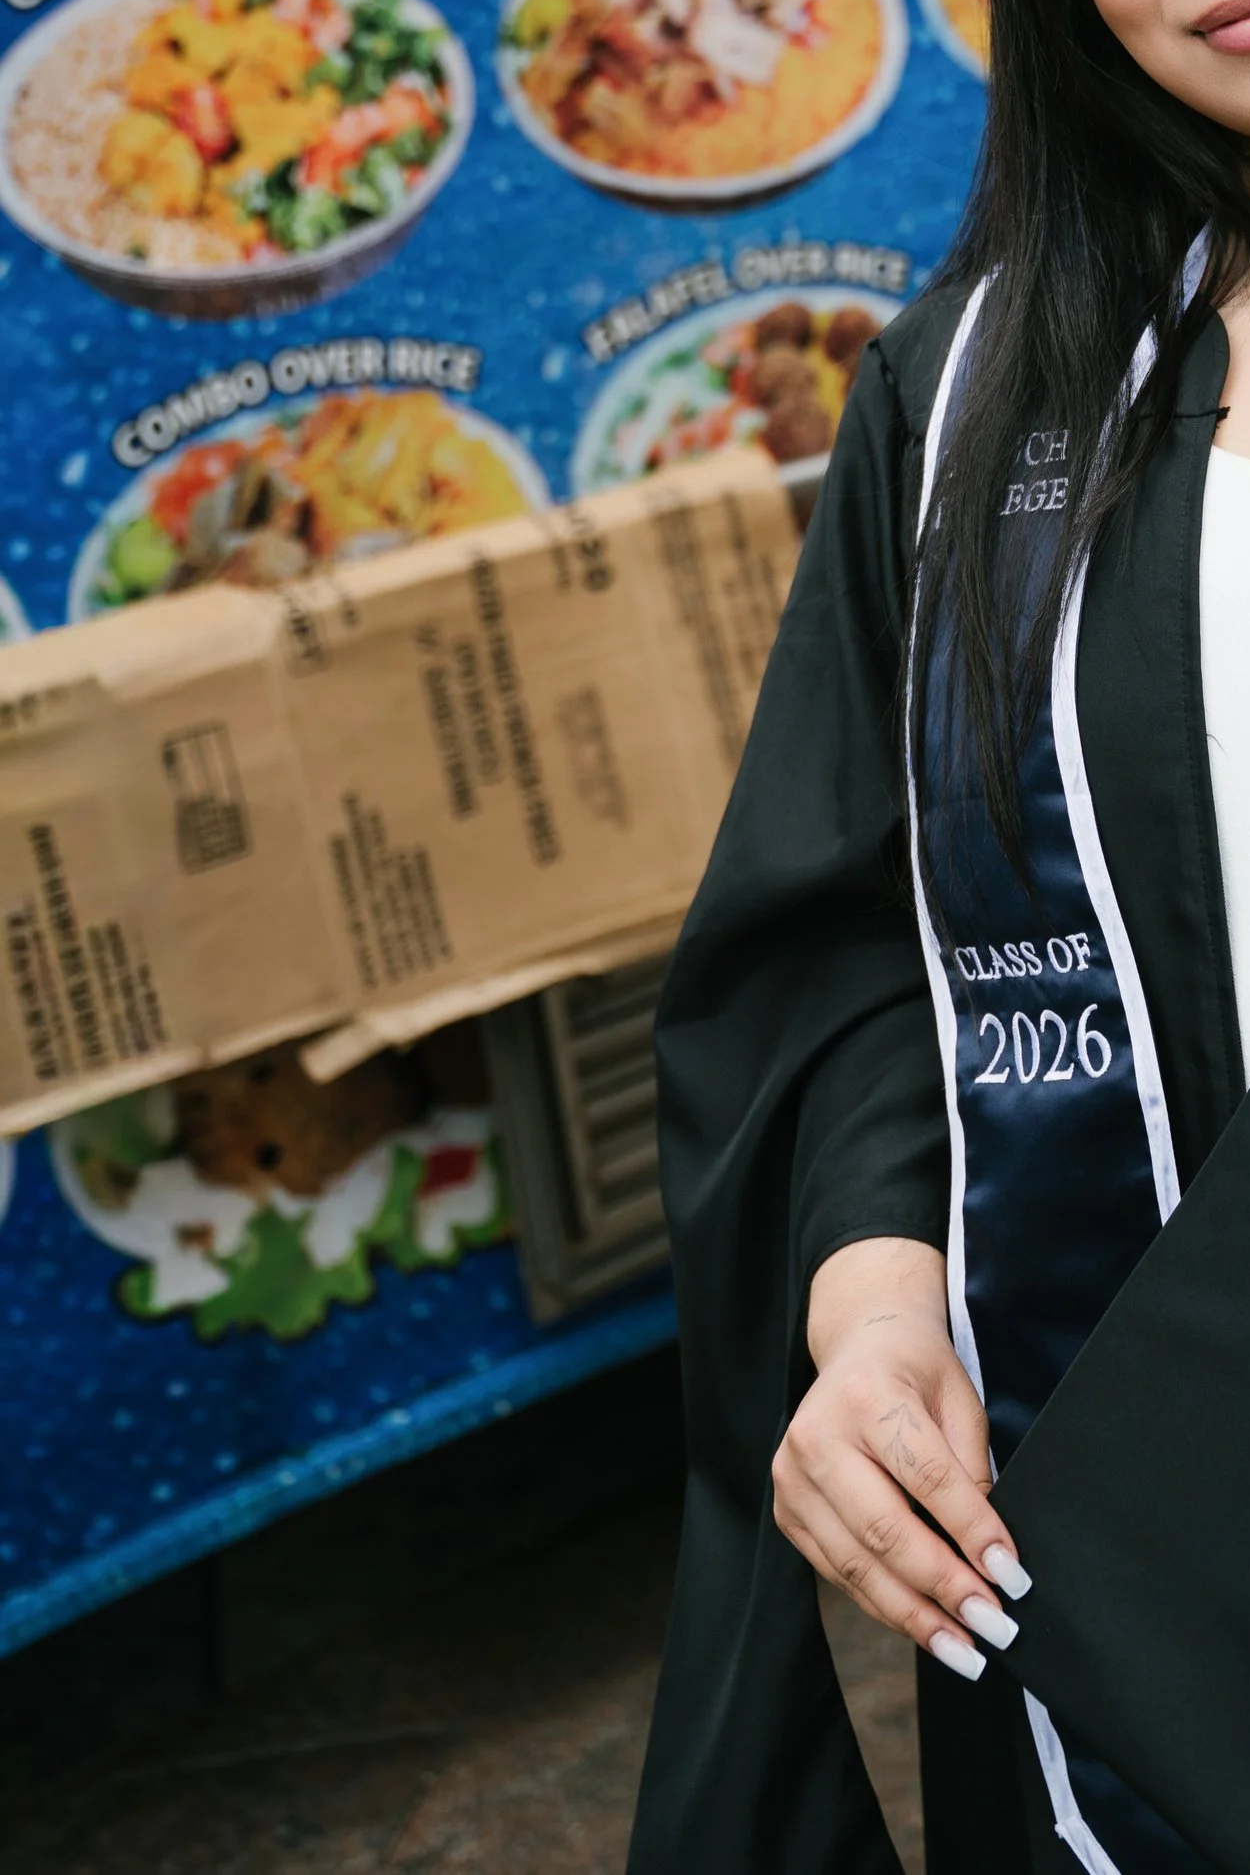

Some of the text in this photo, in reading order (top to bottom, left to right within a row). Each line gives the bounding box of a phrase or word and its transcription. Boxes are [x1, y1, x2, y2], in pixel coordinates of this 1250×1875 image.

[580, 237, 912, 365] FALAFEL OVER RICE
[111, 335, 484, 469] COMBO OVER RICE
[953, 931, 1093, 983] CLASS OF
[973, 1002, 1114, 1086] 2026
